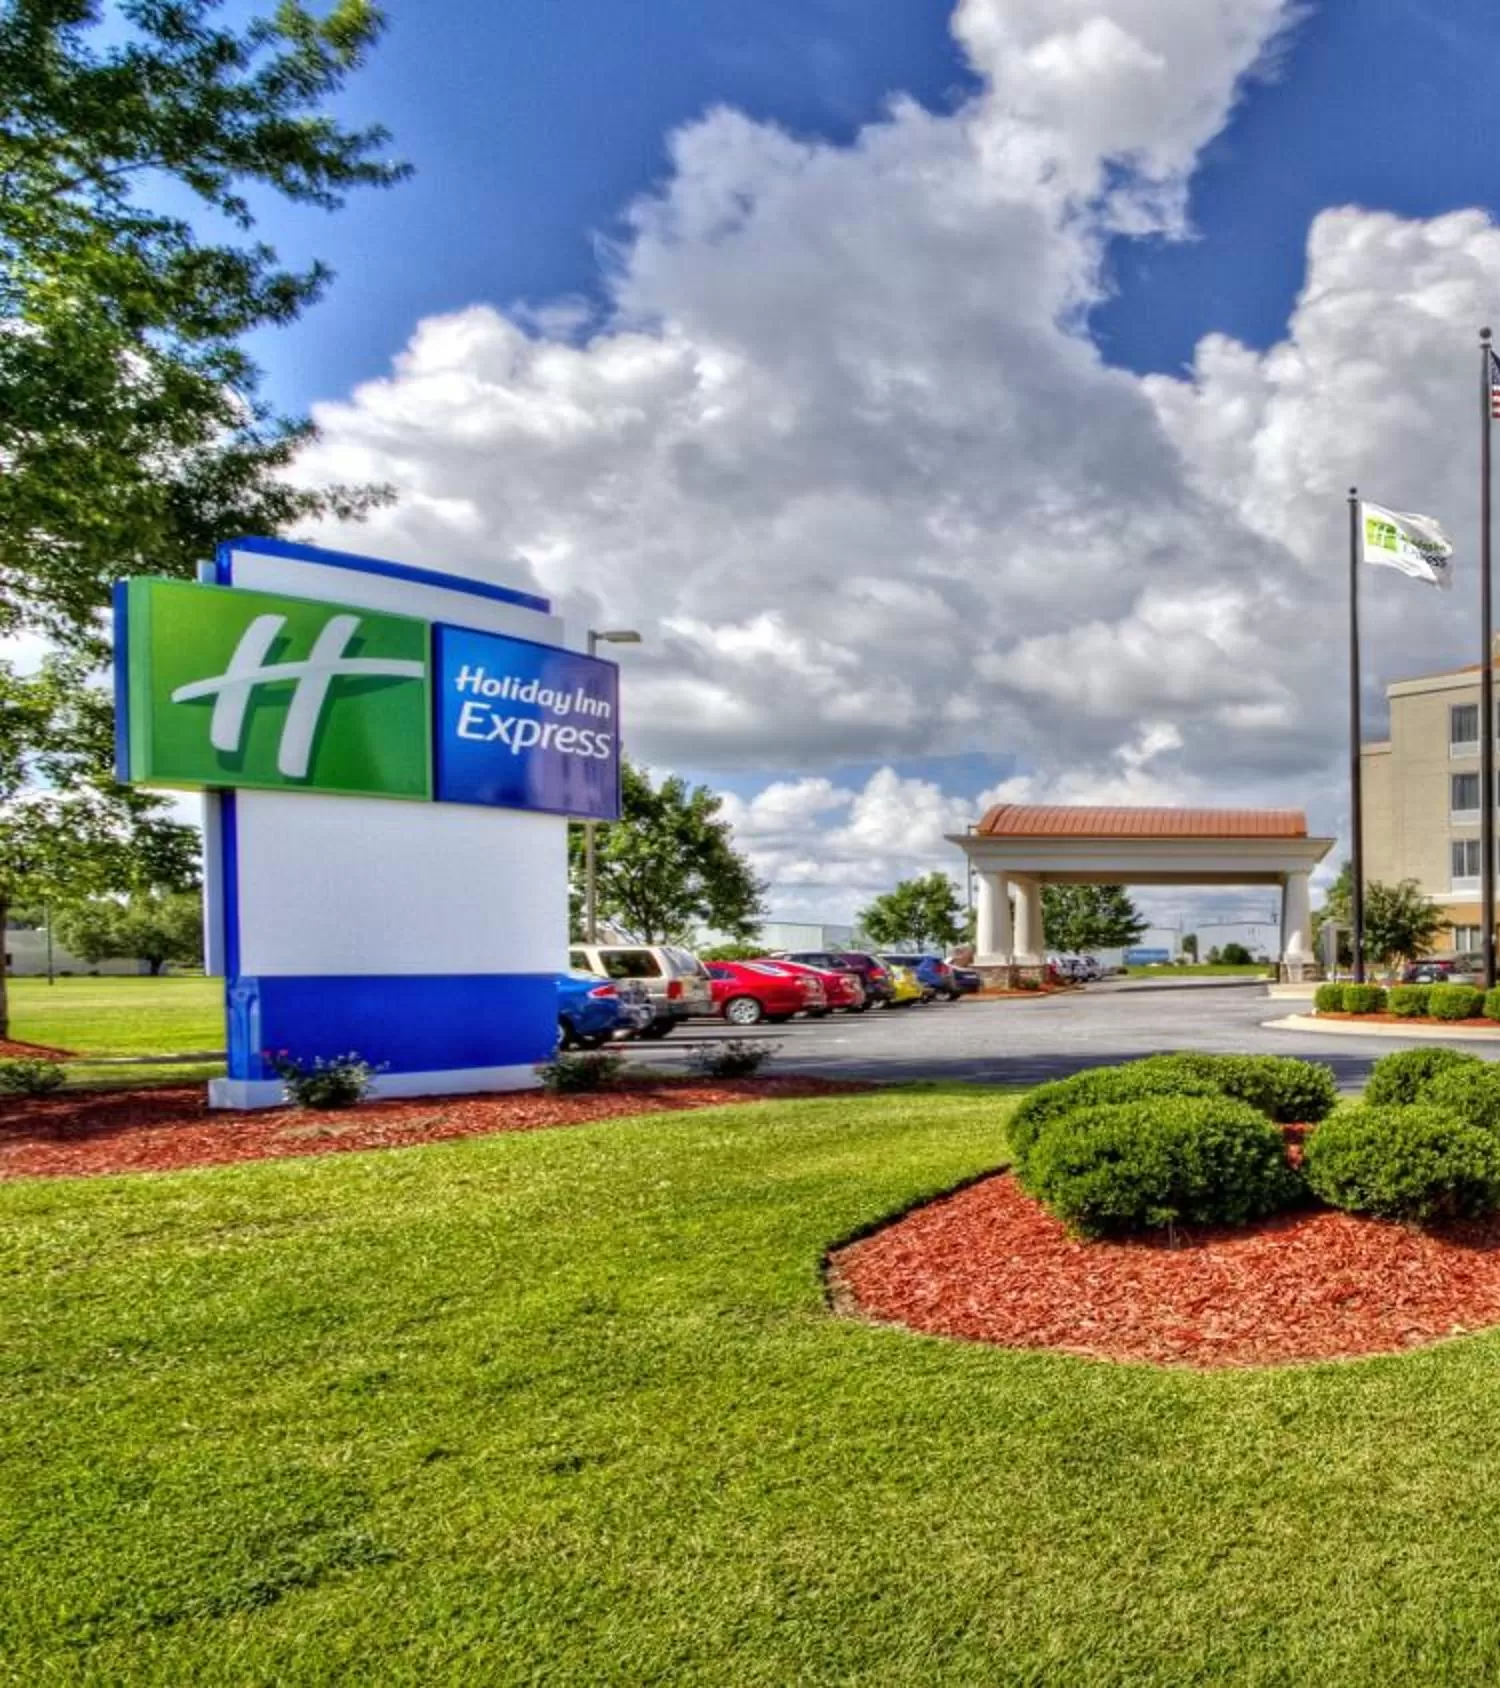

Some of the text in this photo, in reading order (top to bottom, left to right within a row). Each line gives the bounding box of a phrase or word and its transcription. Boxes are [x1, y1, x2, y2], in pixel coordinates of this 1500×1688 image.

[454, 665, 611, 718] Holiday Inn
[457, 701, 611, 759] Express
